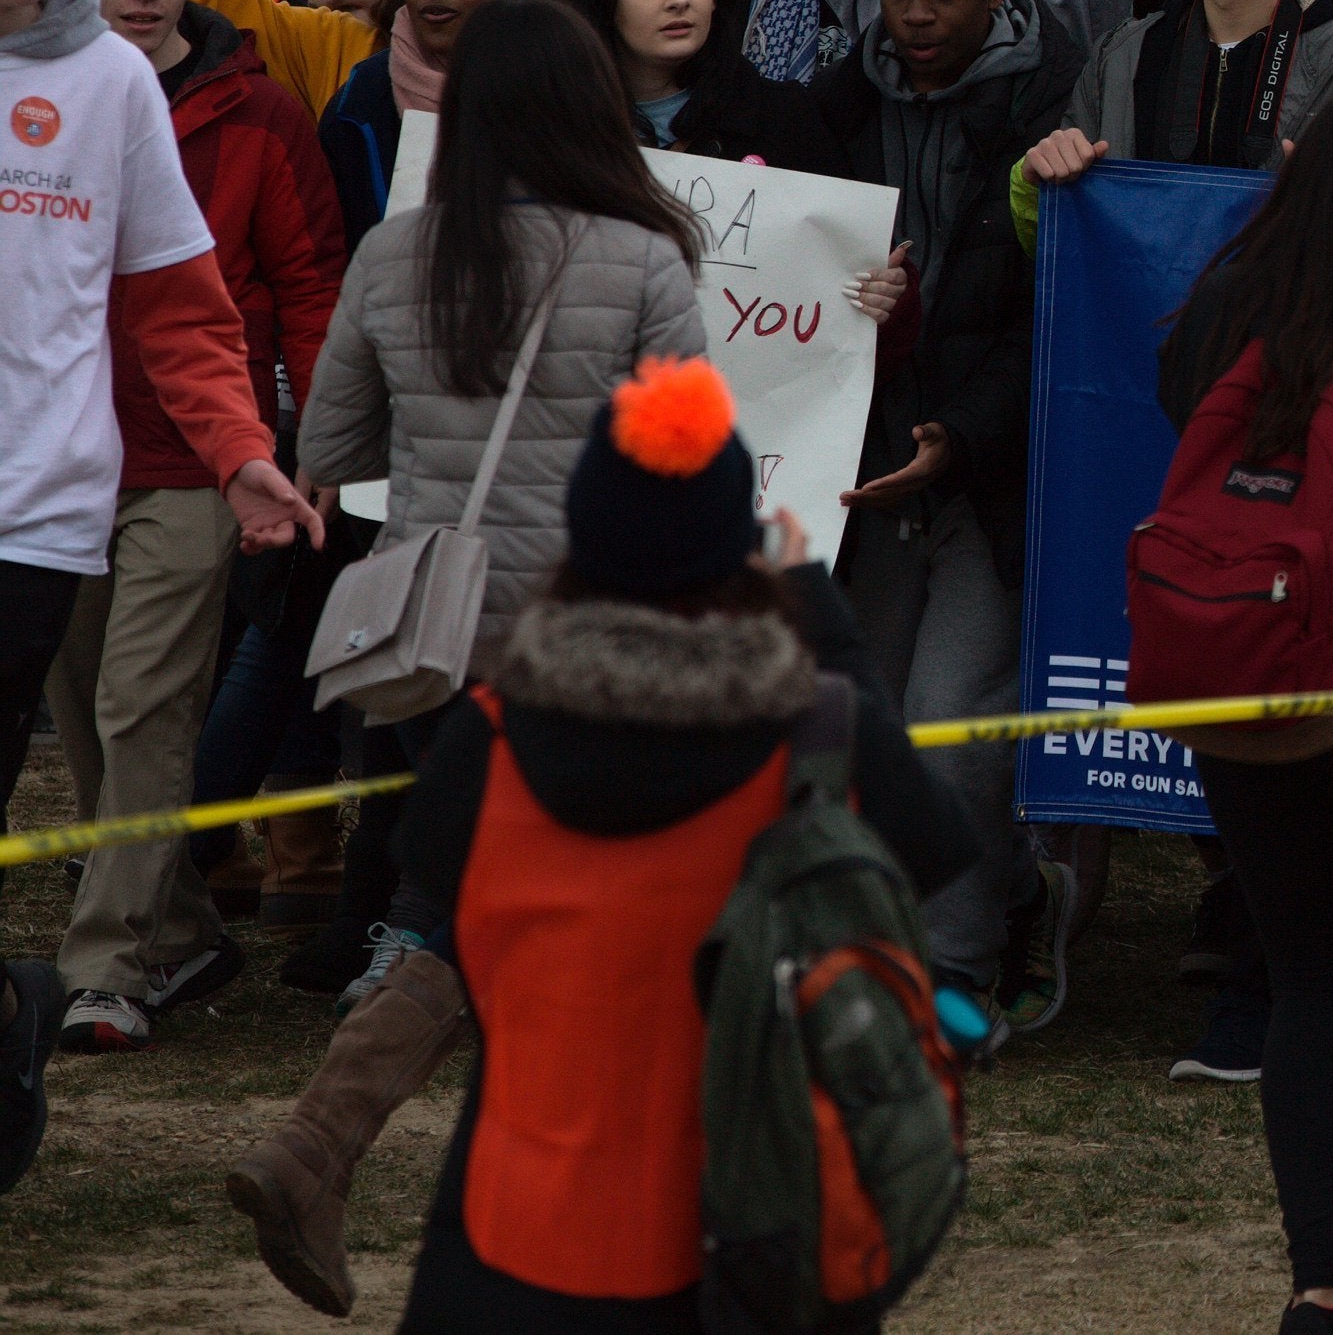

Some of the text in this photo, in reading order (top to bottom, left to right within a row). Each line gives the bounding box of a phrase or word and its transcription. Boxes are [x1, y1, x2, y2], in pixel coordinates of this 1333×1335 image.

[1259, 31, 1289, 120] EOS DIGITAL
[17, 106, 55, 119] ENOUGH
[54, 175, 72, 190] 24
[723, 288, 822, 346] YOU
[1087, 769, 1171, 793] FOR GUN
